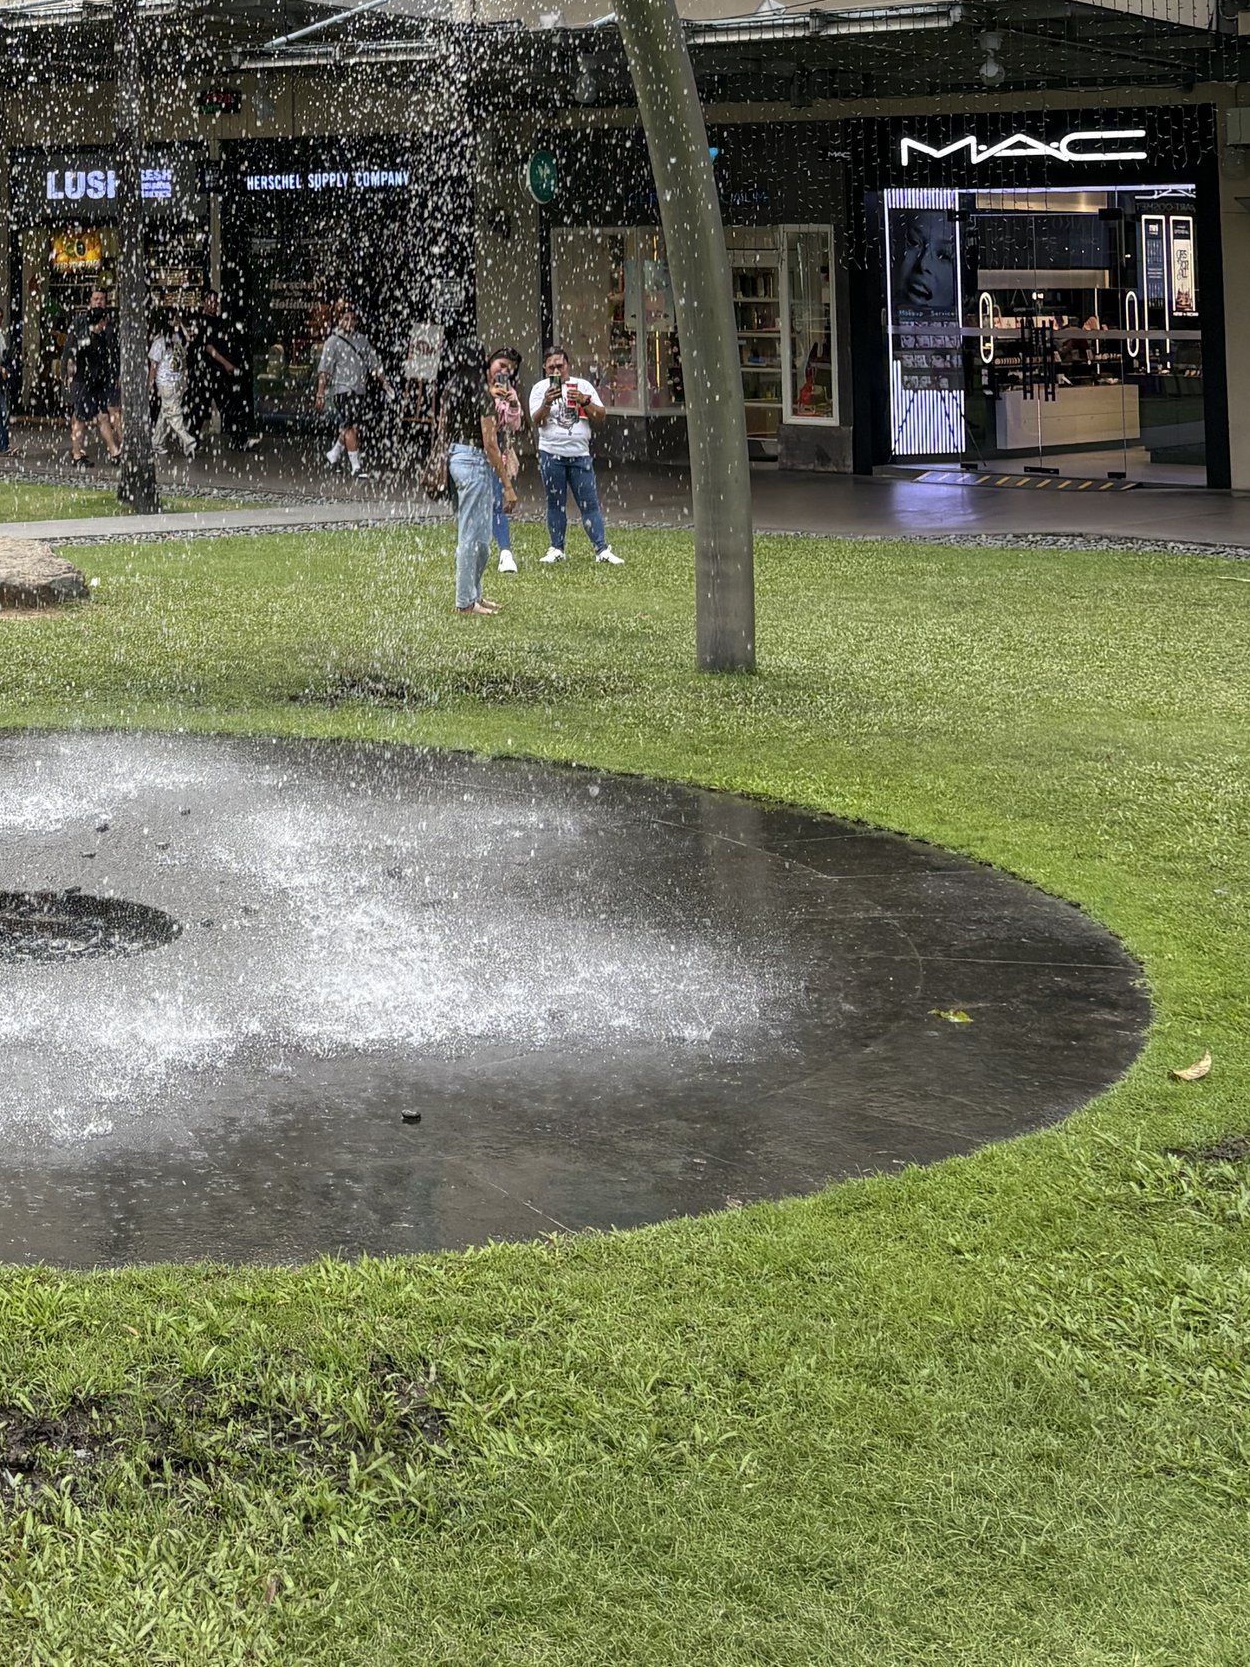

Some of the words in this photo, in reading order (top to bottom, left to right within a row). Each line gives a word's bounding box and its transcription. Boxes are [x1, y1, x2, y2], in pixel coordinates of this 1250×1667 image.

[246, 173, 301, 191] HERSCHEL
[307, 172, 349, 190] SUPPLY
[355, 170, 410, 188] COMPANY
